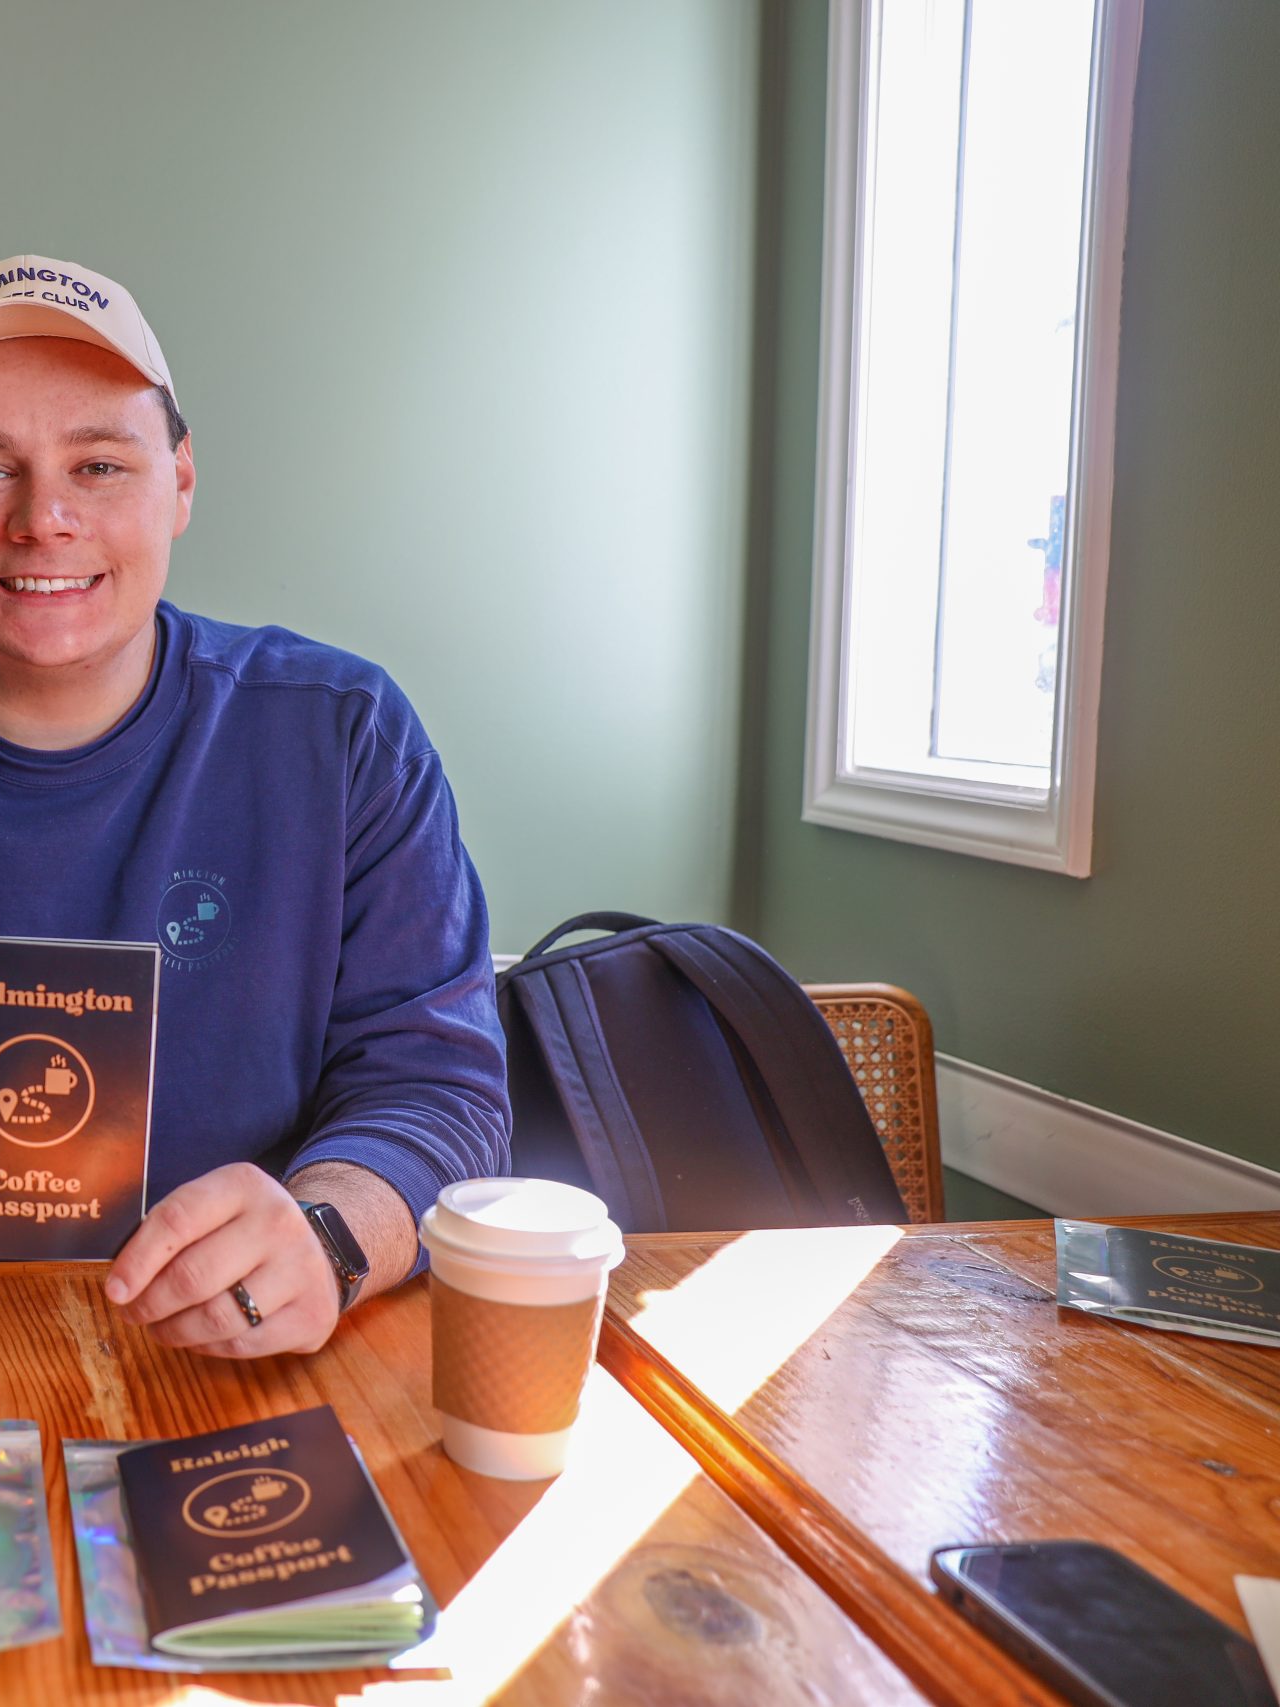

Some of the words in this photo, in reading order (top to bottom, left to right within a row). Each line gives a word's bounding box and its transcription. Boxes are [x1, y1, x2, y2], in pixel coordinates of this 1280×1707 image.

[41, 291, 90, 312] CLUB
[169, 1437, 291, 1473] Raleigh
[188, 1544, 354, 1597] Passport
[208, 1537, 323, 1573] Coffee
